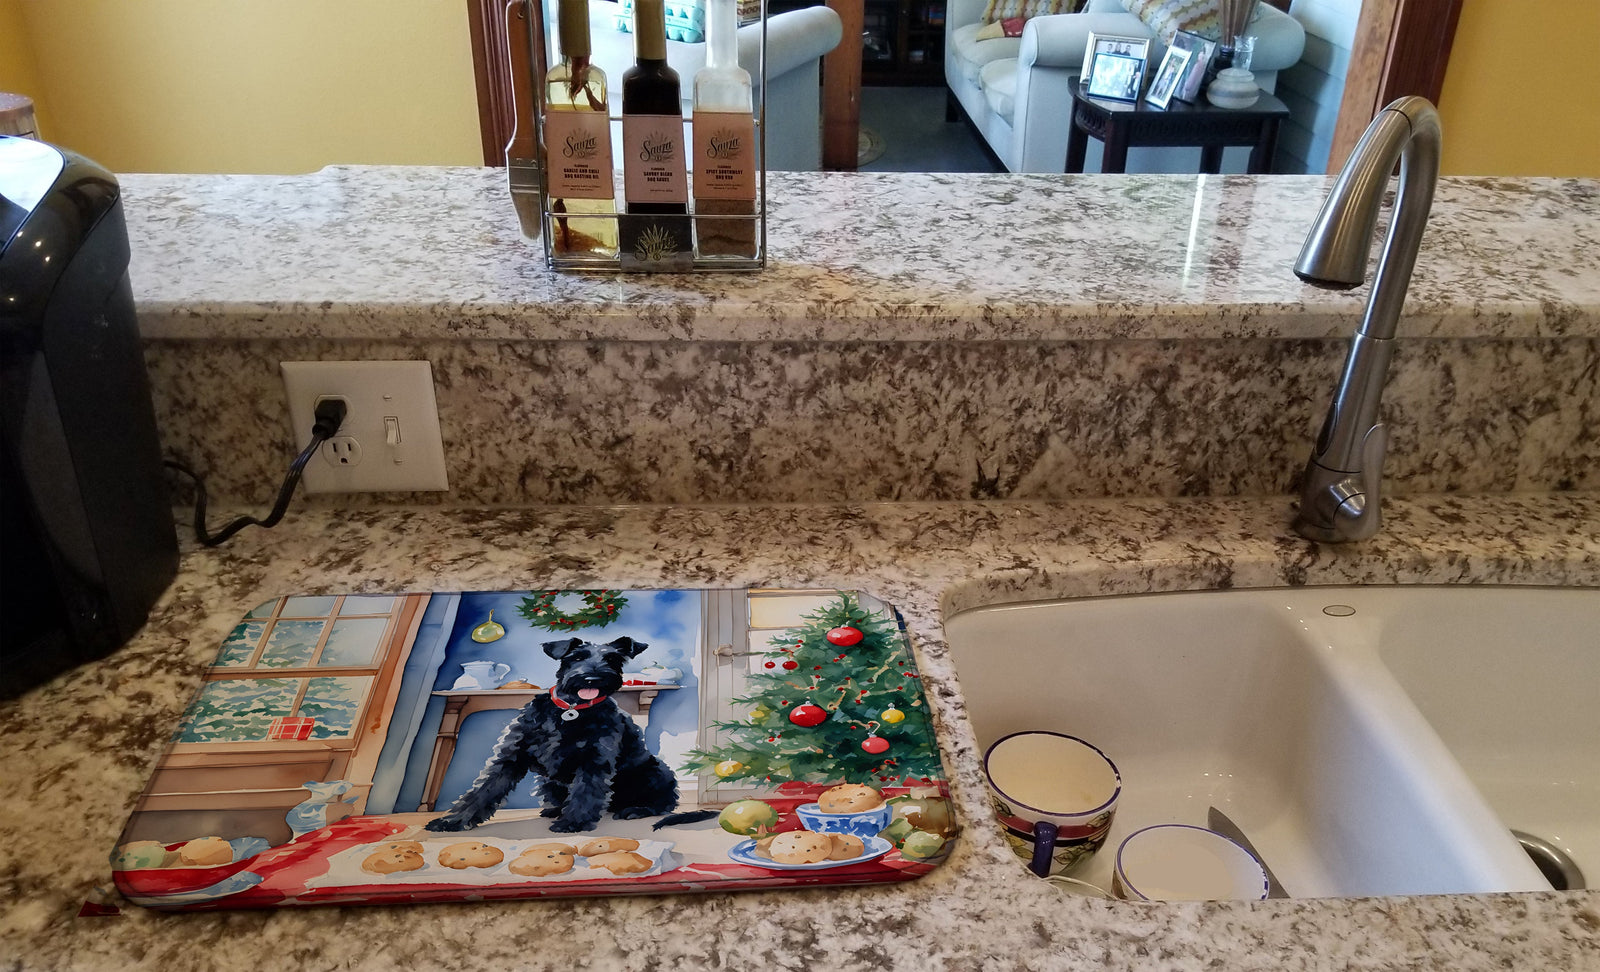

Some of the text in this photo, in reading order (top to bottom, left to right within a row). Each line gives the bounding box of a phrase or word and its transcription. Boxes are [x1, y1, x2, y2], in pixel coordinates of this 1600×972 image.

[563, 136, 597, 158] Sauza
[640, 140, 673, 162] Sauza
[706, 136, 740, 159] Sauza
